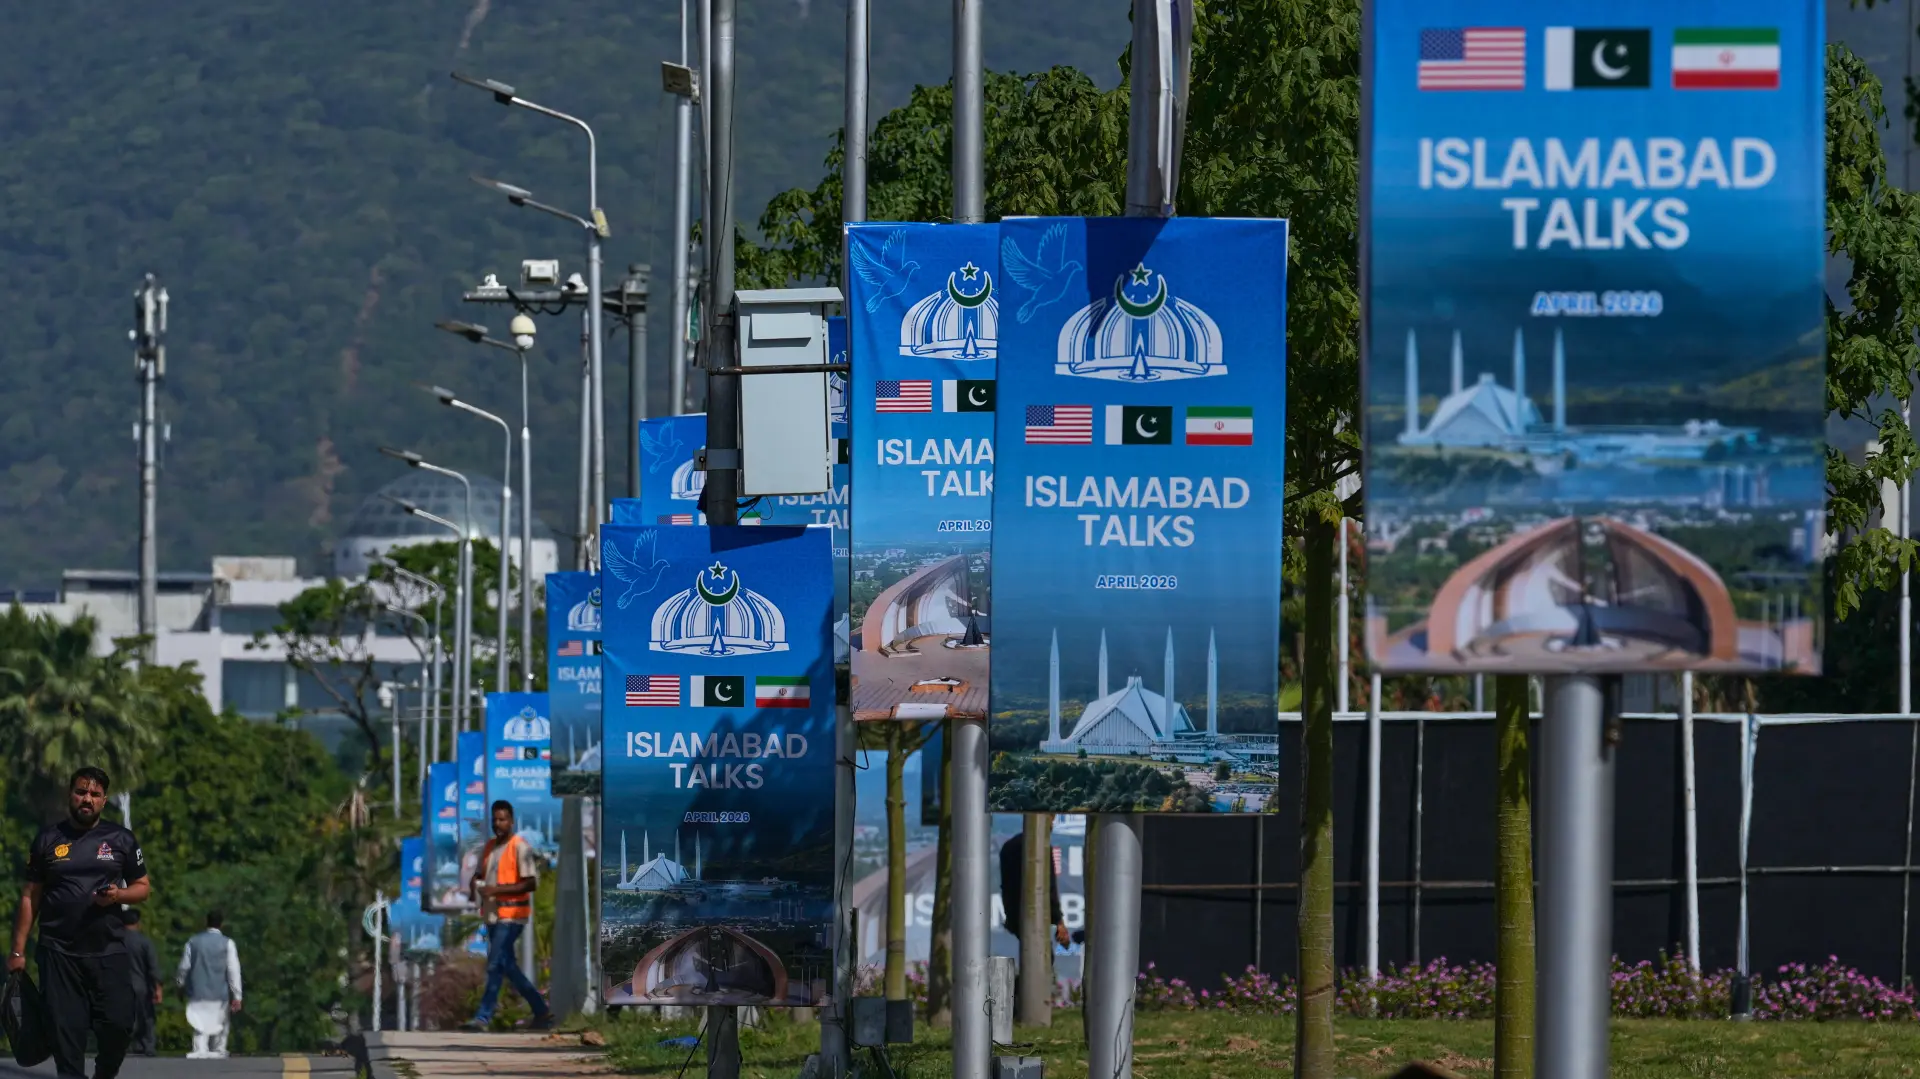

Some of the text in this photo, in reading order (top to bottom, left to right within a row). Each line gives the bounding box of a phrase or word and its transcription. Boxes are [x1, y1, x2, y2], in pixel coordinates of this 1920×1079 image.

[1418, 137, 1777, 190] ISLAMABAD
[1502, 197, 1690, 250] TALKS
[1531, 290, 1664, 317] APRIL 2026
[877, 438, 994, 466] ISLAMA
[1025, 475, 1250, 509] ISLAMABAD
[938, 520, 991, 532] APRIL 20
[1077, 514, 1195, 547] TALKS
[1096, 574, 1178, 590] APRIL 2026
[626, 731, 808, 759] ISLAMABAD
[669, 763, 764, 789] TALKS
[684, 811, 751, 823] APRIL 2026
